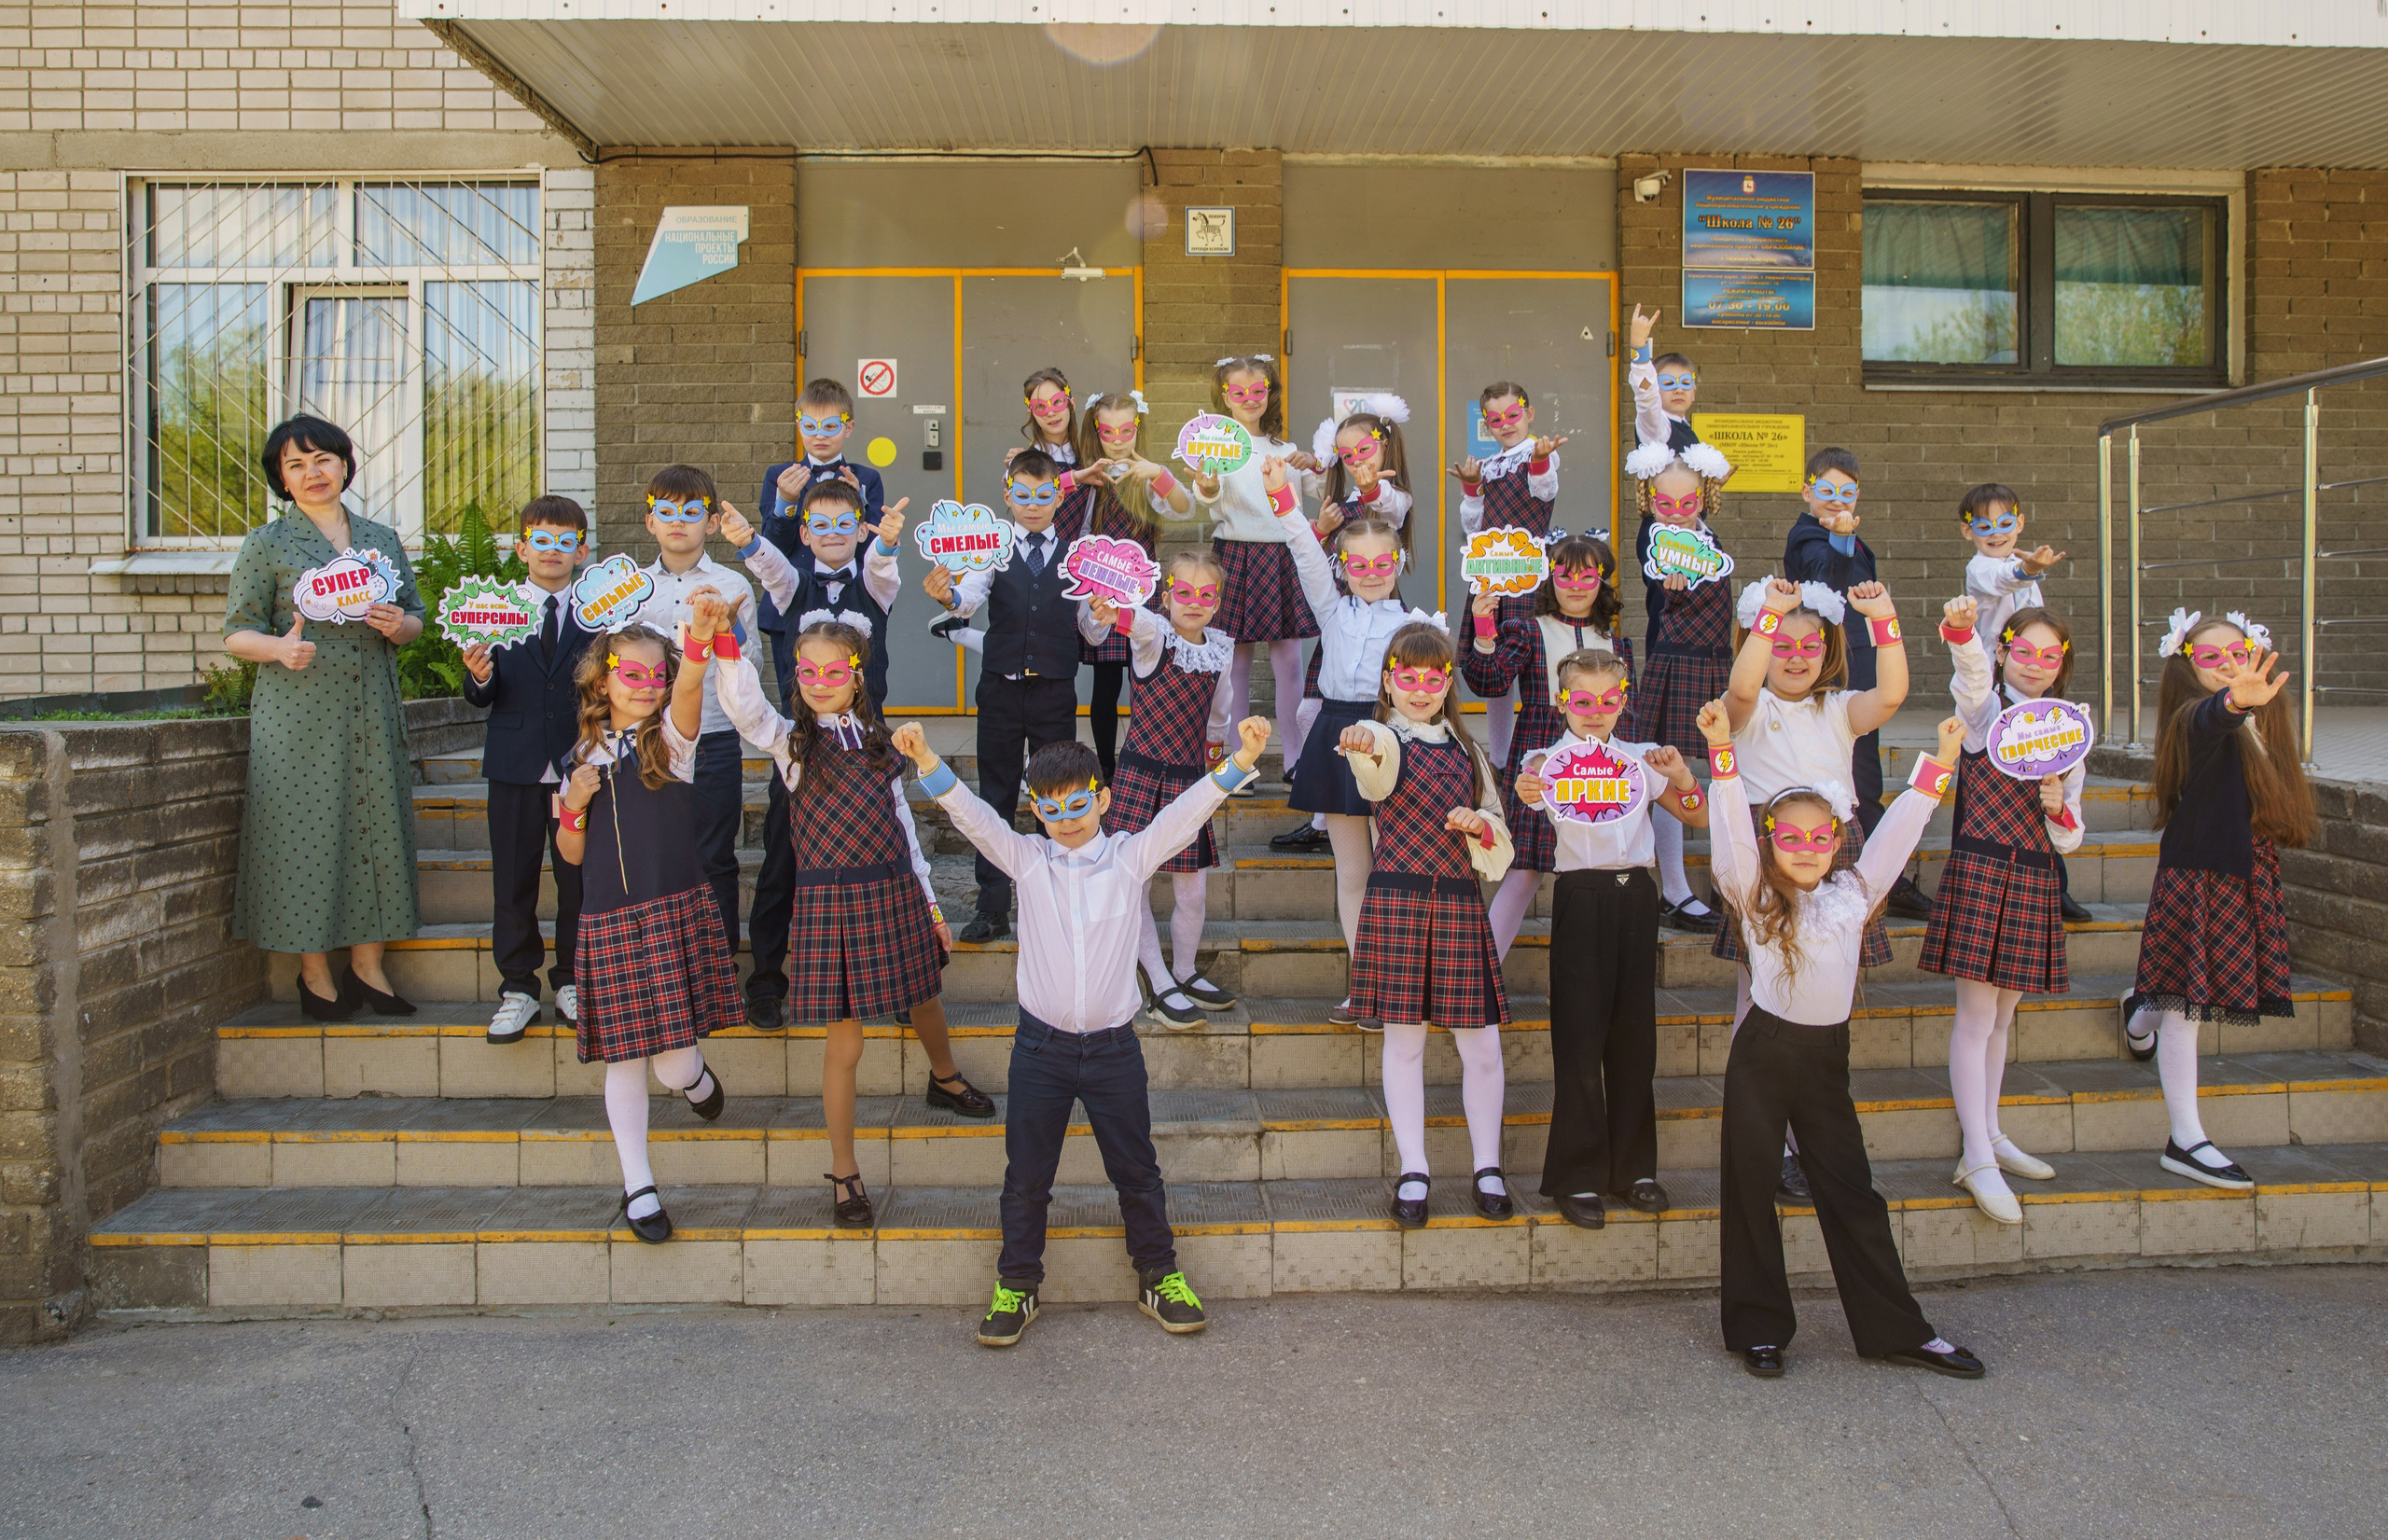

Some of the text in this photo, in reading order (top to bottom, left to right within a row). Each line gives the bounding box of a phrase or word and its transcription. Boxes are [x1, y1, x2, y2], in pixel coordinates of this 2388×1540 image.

[675, 215, 737, 224] ОБРАЗОВАНИЕ
[665, 231, 735, 243] НАЦИОНАЛЬНЫЕ
[695, 243, 735, 254] ПРОЕКТЫ
[702, 254, 735, 264] РОССИИ
[1708, 301, 1743, 310] 07.30
[1756, 302, 1790, 311] 19.00
[1709, 431, 1754, 440] «ШКОЛА
[1756, 432, 1769, 440] №
[1187, 441, 1242, 458] КРУТЫЕ
[937, 521, 990, 534] Мы самые
[930, 533, 1000, 554] СМЕЛЫЕ
[1659, 534, 1696, 553] Самые
[1096, 550, 1132, 573] САМЫЕ
[1465, 559, 1543, 574] АКТИВНЫЕ
[1658, 546, 1717, 576] УМНЫЕ
[312, 567, 370, 596] СУПЕР
[1079, 560, 1139, 594] НЕЖНЫЕ
[589, 576, 618, 597] Самые
[337, 590, 372, 607] КЛАСС
[582, 573, 646, 621] СИЛЬНЫЕ
[451, 611, 528, 625] СУПЕРСИЛЫ
[2017, 725, 2061, 741] Мы самые
[1999, 728, 2083, 760] ТВОРЧЕСКИЕ
[1573, 763, 1614, 776] Самые
[1556, 780, 1630, 801] ЯРКИЕ
